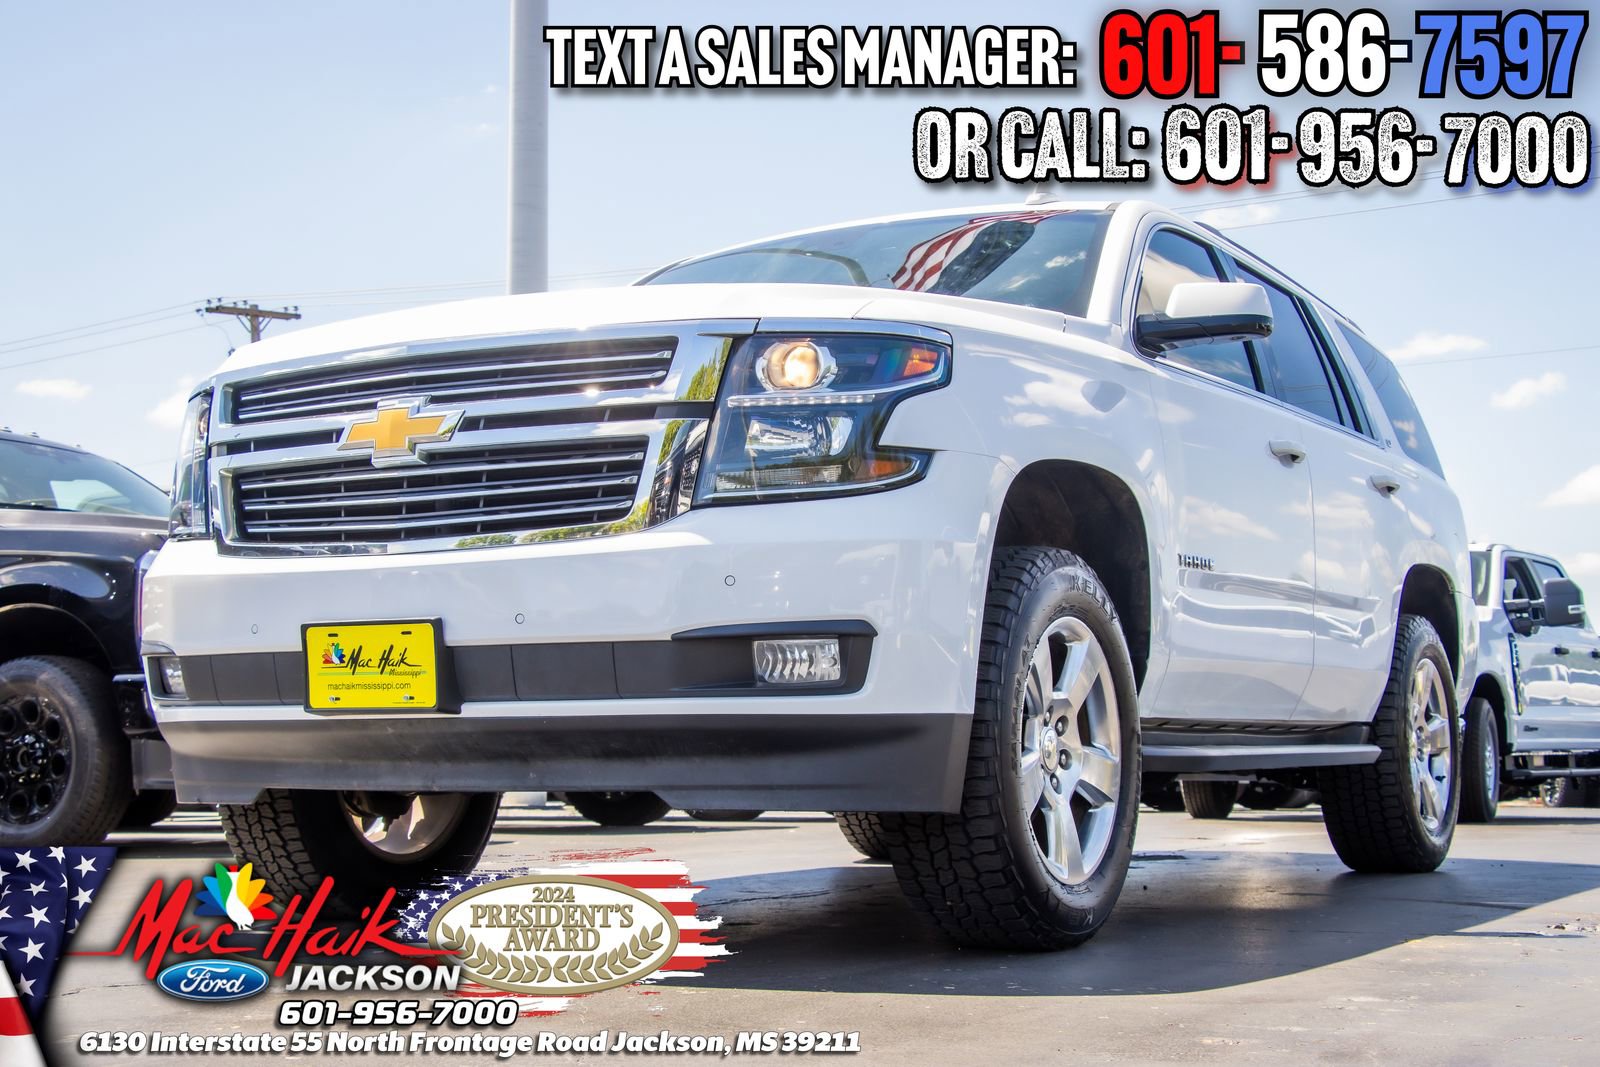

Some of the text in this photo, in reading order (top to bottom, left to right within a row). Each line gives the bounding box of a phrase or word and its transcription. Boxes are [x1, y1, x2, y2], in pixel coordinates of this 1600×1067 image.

[345, 644, 422, 675] Mac Haik
[388, 668, 422, 679] Mississippi
[327, 681, 412, 692] machaikmississippi.com
